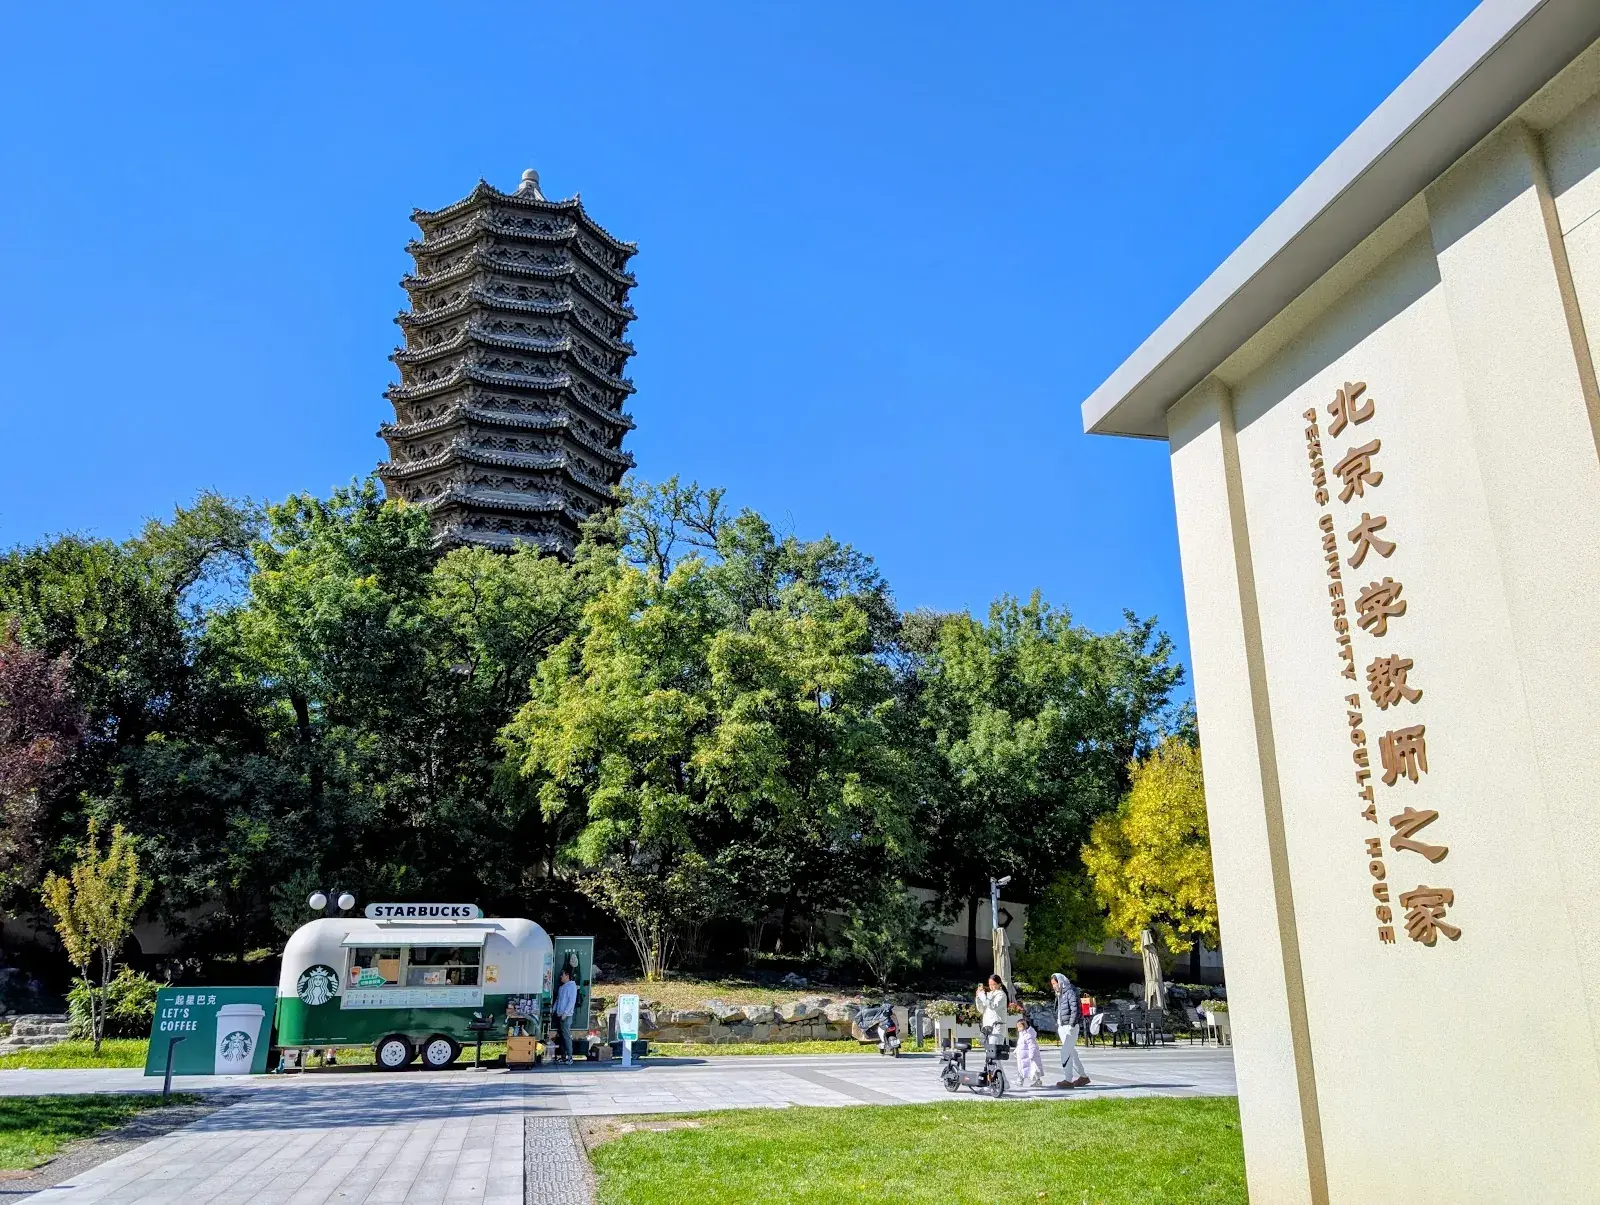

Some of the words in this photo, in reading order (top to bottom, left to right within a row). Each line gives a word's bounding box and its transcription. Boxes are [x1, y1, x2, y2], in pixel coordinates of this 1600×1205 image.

[1327, 381, 1461, 947] 北京大学教师之家
[1302, 407, 1330, 506] PEKING
[1318, 513, 1357, 682] UNIVERSITY
[1344, 693, 1378, 825] FACULTY
[1364, 837, 1396, 944] HOUSE
[374, 906, 471, 917] STARBUCKS
[164, 994, 217, 1006] 一起星巴克
[160, 1020, 198, 1031] COFFEE
